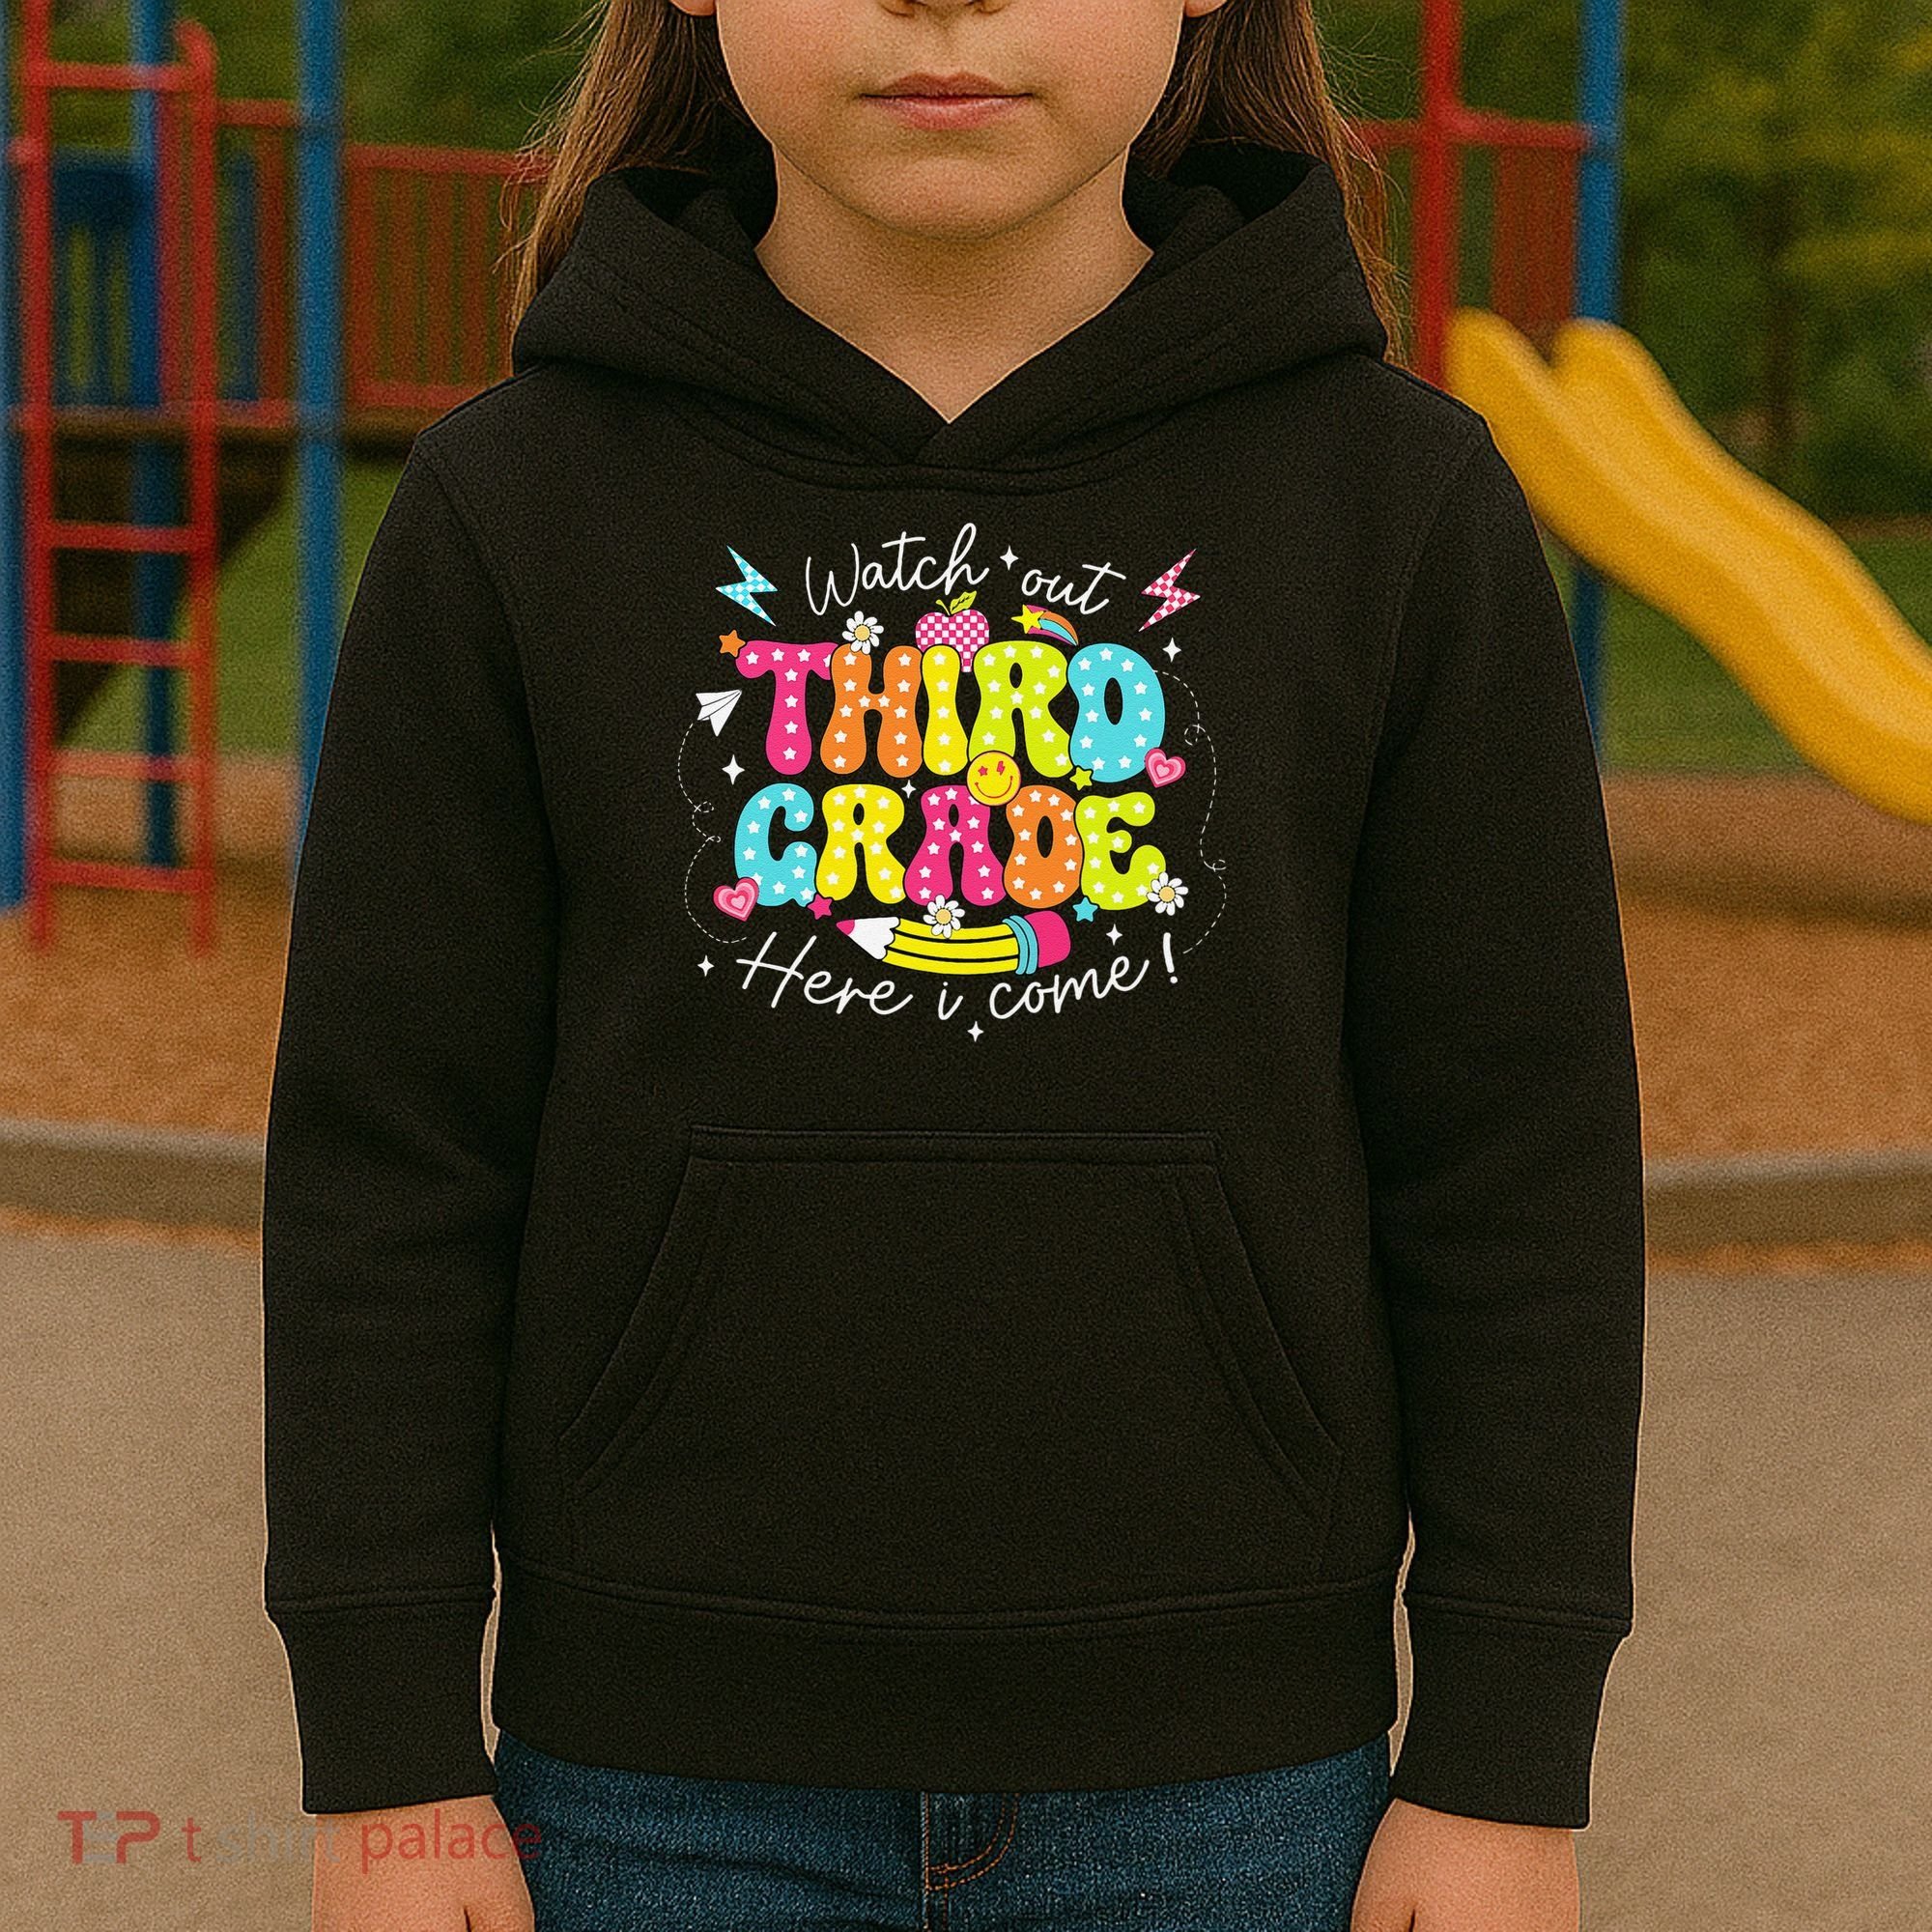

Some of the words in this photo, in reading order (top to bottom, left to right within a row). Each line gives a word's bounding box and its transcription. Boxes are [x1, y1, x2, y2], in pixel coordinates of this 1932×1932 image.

[805, 522, 990, 616] Watch
[1020, 561, 1127, 613] out
[735, 639, 1167, 783] THIRD
[733, 781, 1167, 911] GRADE
[735, 931, 914, 1015] Here
[936, 980, 964, 1021] i
